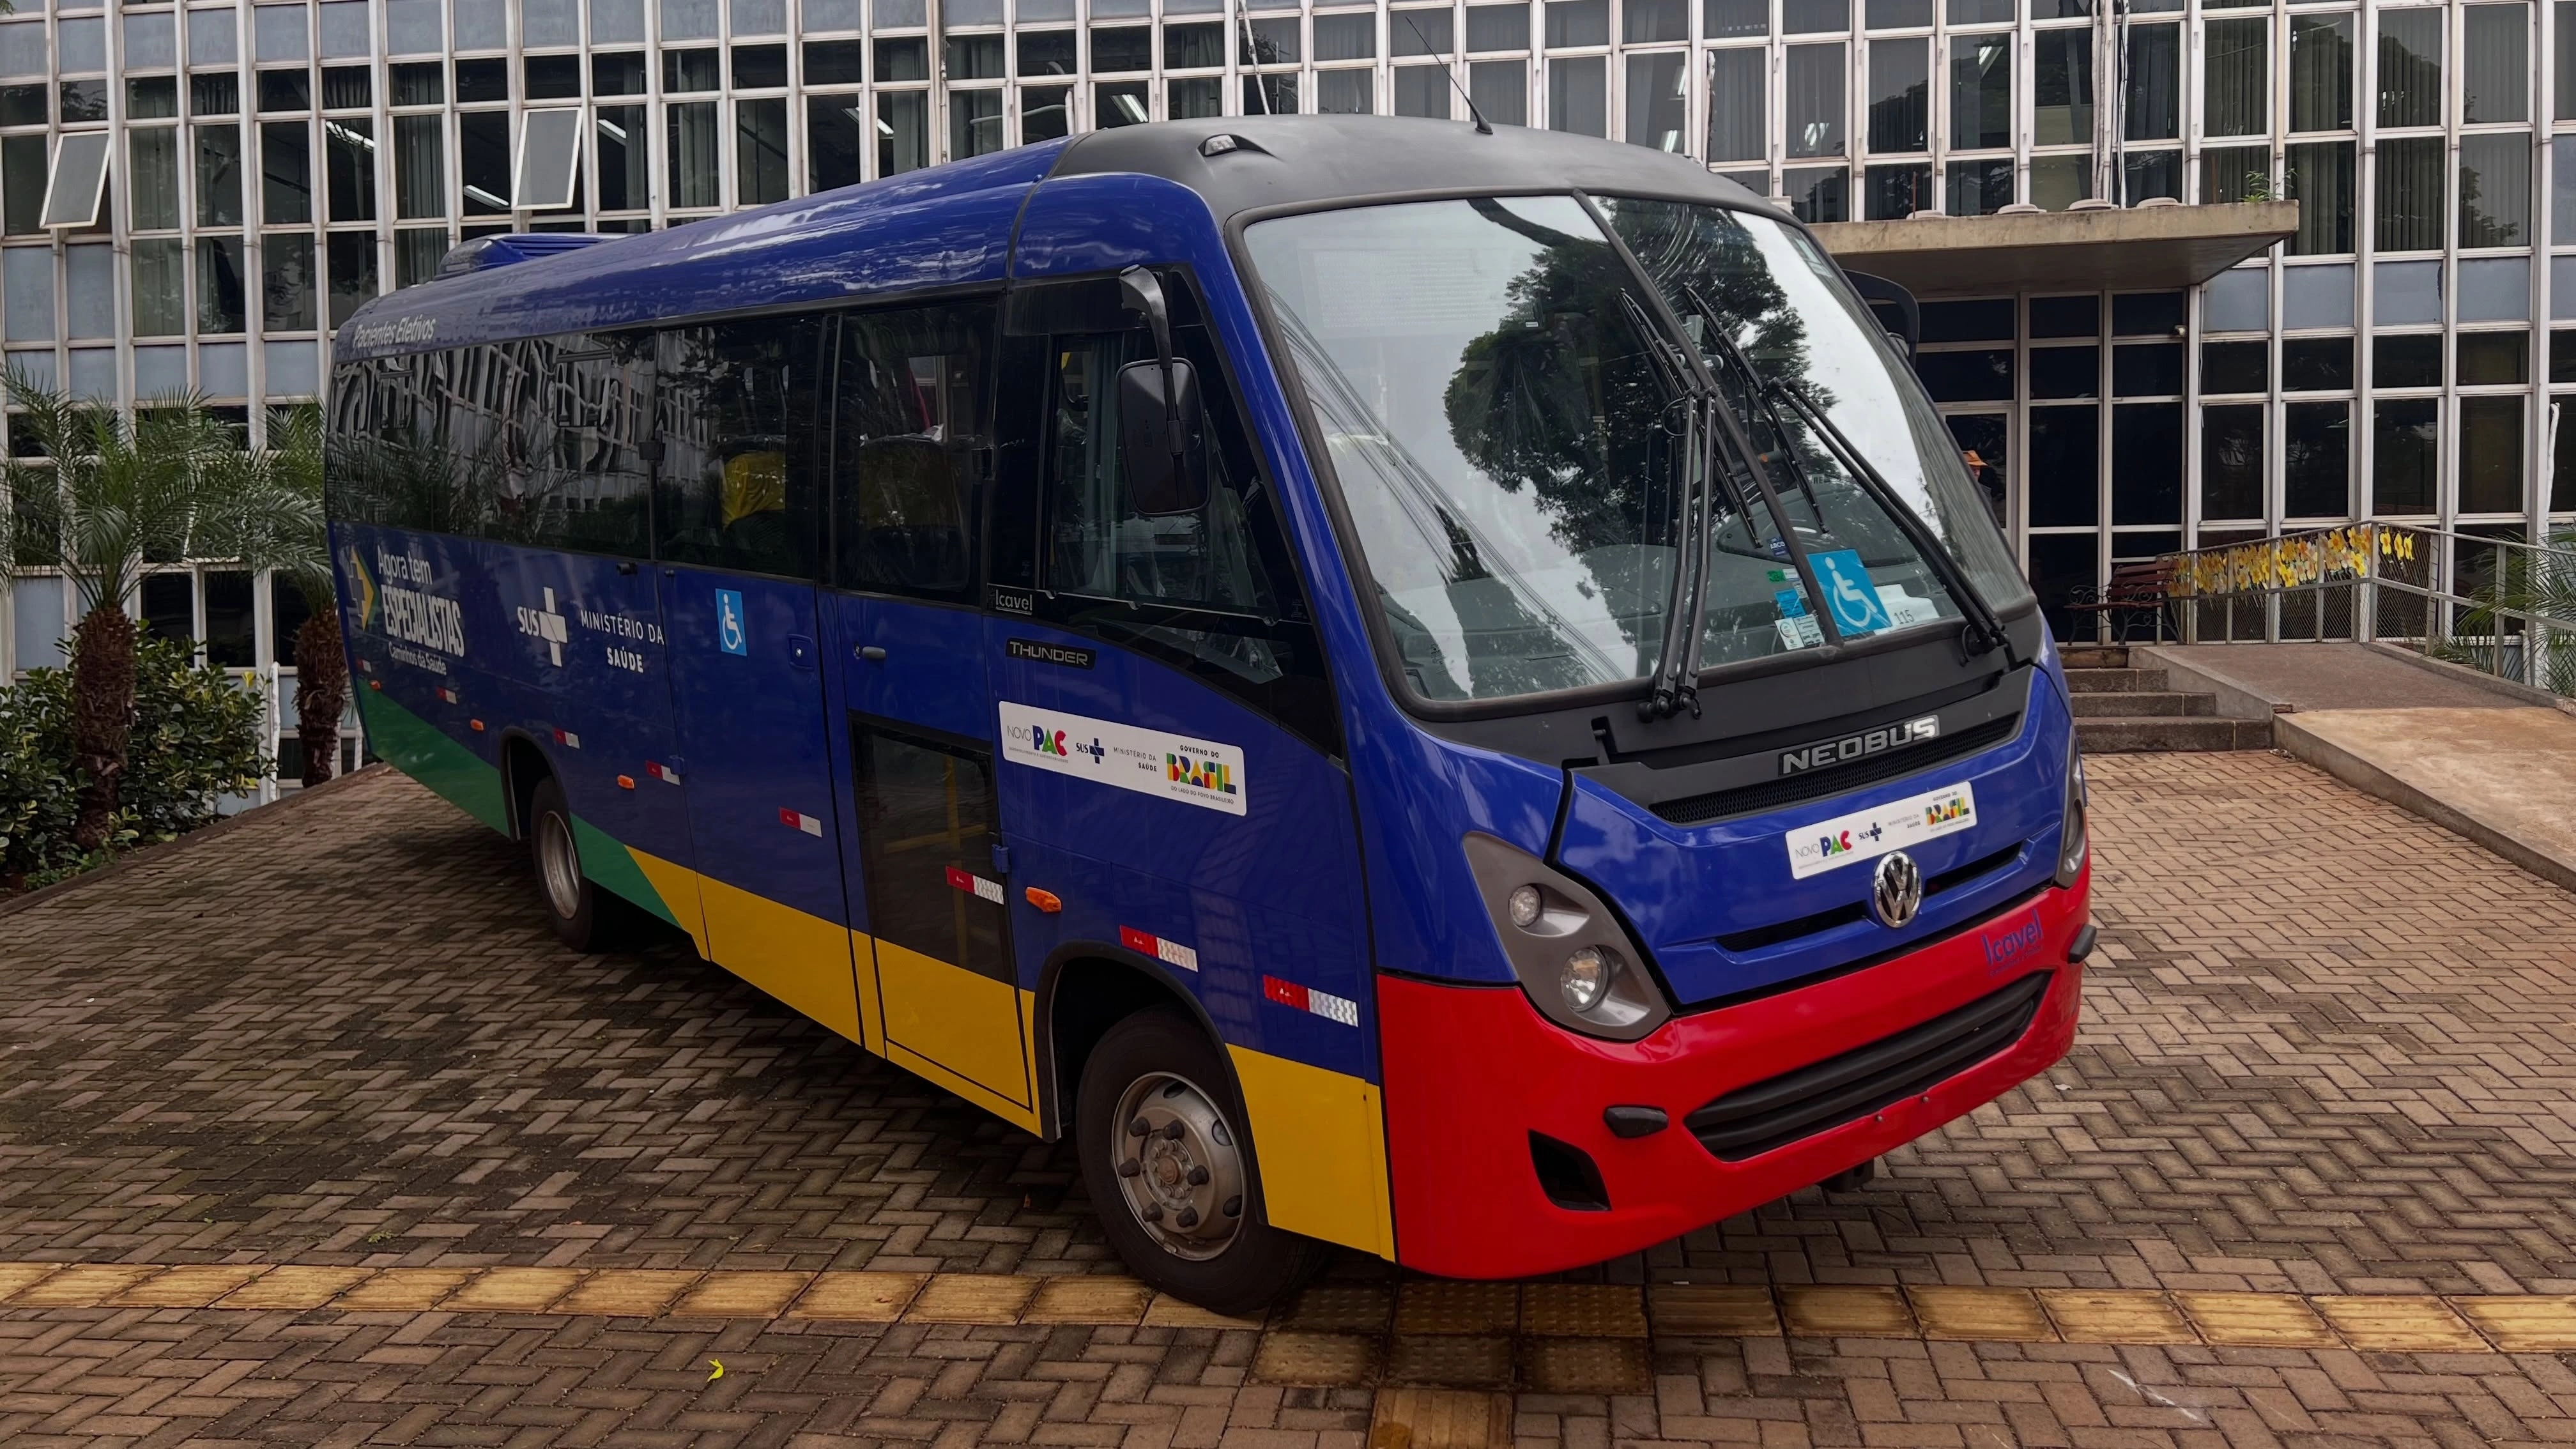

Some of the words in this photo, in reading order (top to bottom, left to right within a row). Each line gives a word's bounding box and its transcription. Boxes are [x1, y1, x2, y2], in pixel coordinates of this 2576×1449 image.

[353, 321, 396, 348] Pacientes
[395, 314, 436, 343] Eletivos
[378, 545, 409, 585] Agora
[408, 550, 432, 585] tem
[381, 584, 464, 657] ESPECIALISTAS
[518, 606, 539, 636] SUS
[580, 610, 643, 640] MINISTÉRIO
[648, 623, 664, 645] DA
[1894, 610, 1914, 624] 115
[388, 641, 418, 666] Caminhos
[417, 649, 426, 668] da
[425, 652, 447, 675] Saúde
[607, 646, 643, 673] SAÚDE
[1009, 641, 1088, 665] THUNDER
[1007, 725, 1032, 741] NOVO
[1032, 724, 1068, 756] PAC
[1076, 742, 1089, 753] SUS
[1114, 746, 1147, 760] MINISTÉRIO
[1180, 744, 1208, 756] GOVERNO
[1211, 750, 1219, 758] DO
[1783, 717, 1936, 774] NEOBUS
[1138, 762, 1157, 772] SAÚDE
[1166, 753, 1237, 795] BRASIL
[1210, 794, 1234, 805] BRASILEIRO
[1926, 797, 1970, 825] BRASIL
[1795, 843, 1820, 858] NOVO
[1820, 830, 1852, 857] PAC
[1859, 831, 1869, 840] SUS
